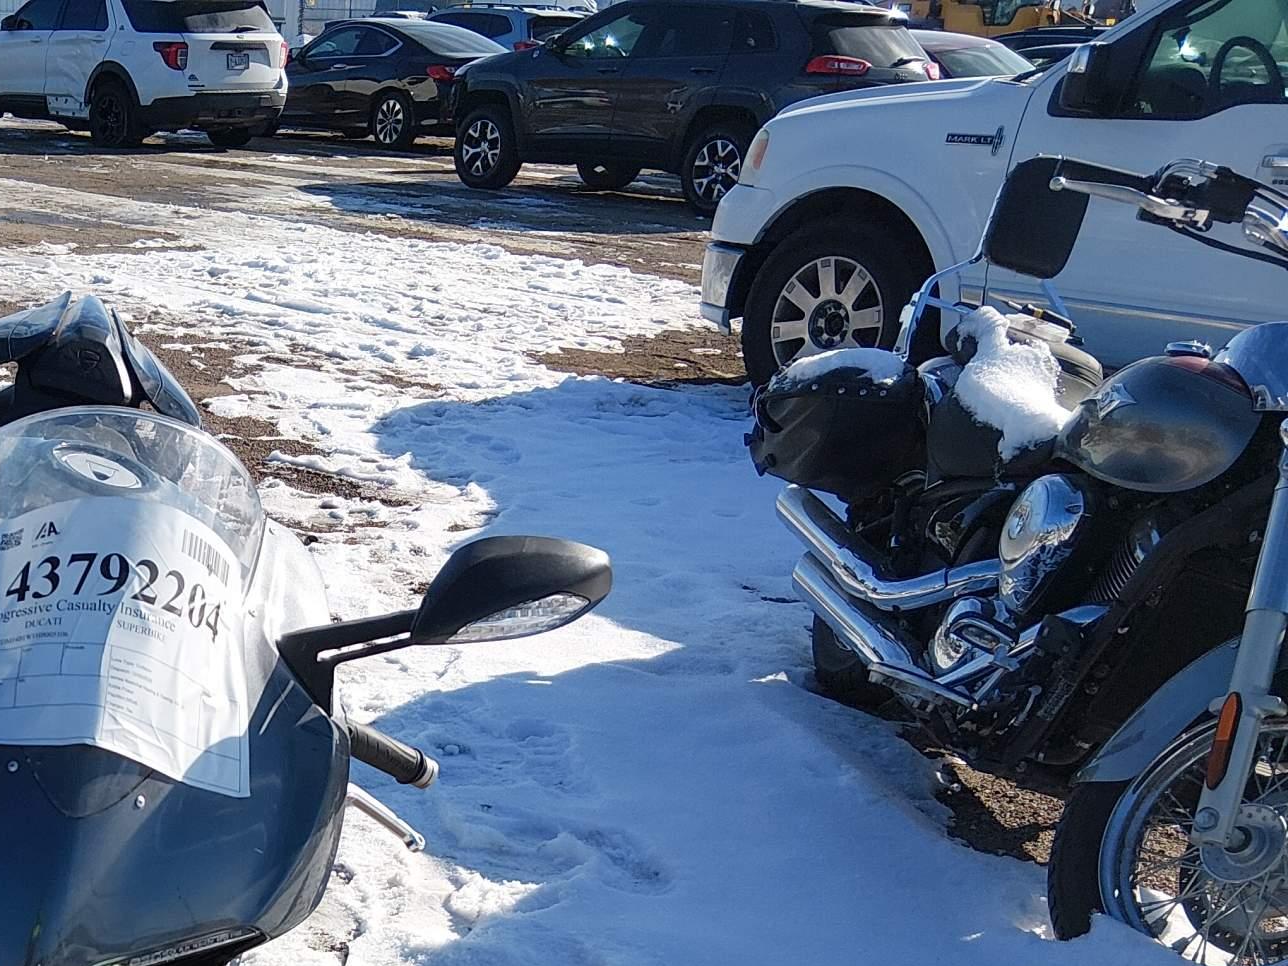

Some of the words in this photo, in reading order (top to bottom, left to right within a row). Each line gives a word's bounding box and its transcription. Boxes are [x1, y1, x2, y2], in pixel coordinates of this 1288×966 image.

[947, 135, 978, 143] MARK
[6, 552, 221, 643] 43792204
[25, 617, 62, 629] DUCATI
[116, 619, 167, 642] SUPERBIKE
[56, 598, 115, 616] Casualty
[120, 601, 177, 632] Insurance
